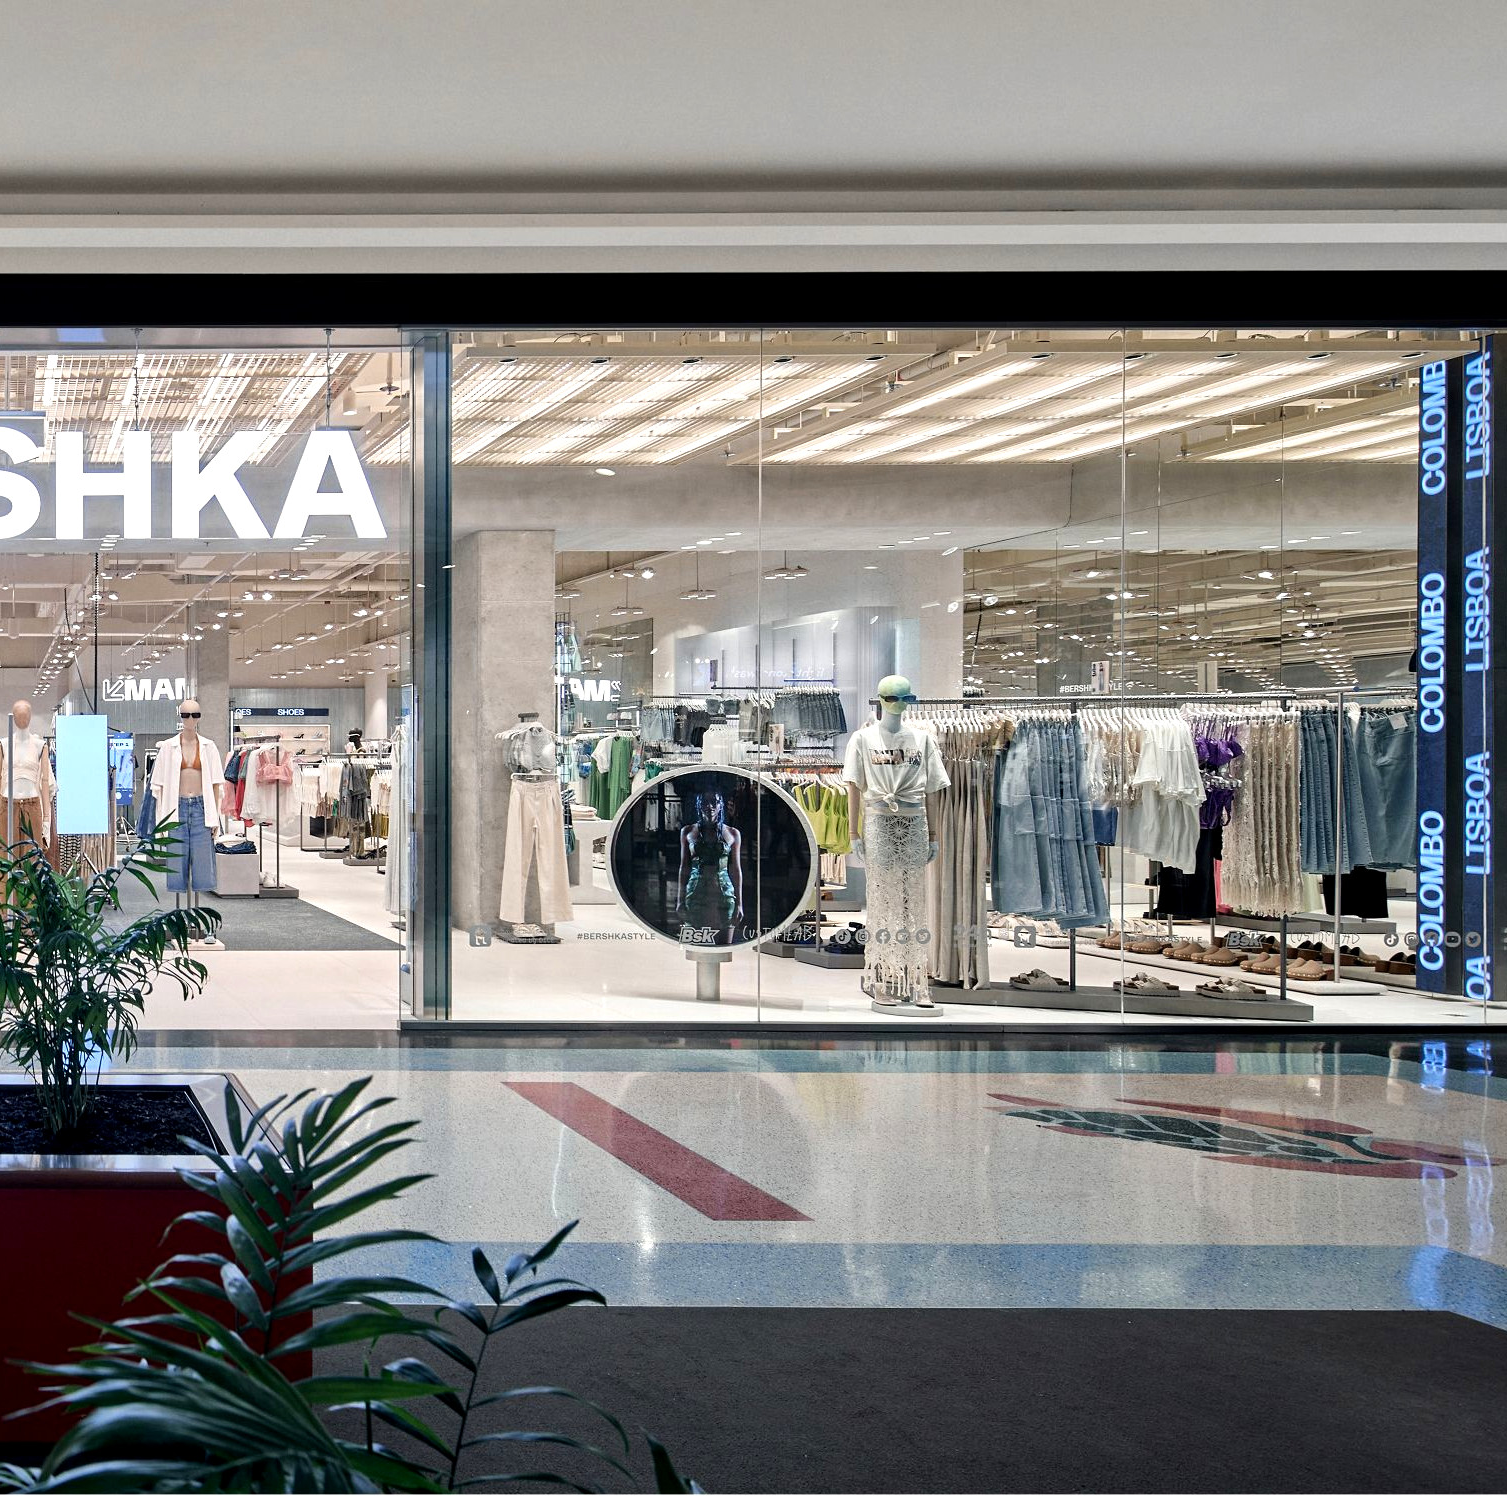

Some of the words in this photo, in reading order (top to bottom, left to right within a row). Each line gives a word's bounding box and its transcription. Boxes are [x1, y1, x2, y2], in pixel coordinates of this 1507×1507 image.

[1421, 359, 1446, 495] COLOMB
[1420, 572, 1446, 734] COLOMBO
[1465, 546, 1490, 672] LISBOA
[277, 708, 304, 716] SHOES
[1059, 683, 1123, 693] #BERSHYLE
[1465, 751, 1490, 875] LISBOA
[681, 928, 715, 944] Bsk
[1228, 932, 1262, 947] Bsk
[1419, 810, 1445, 971] COLOMBO
